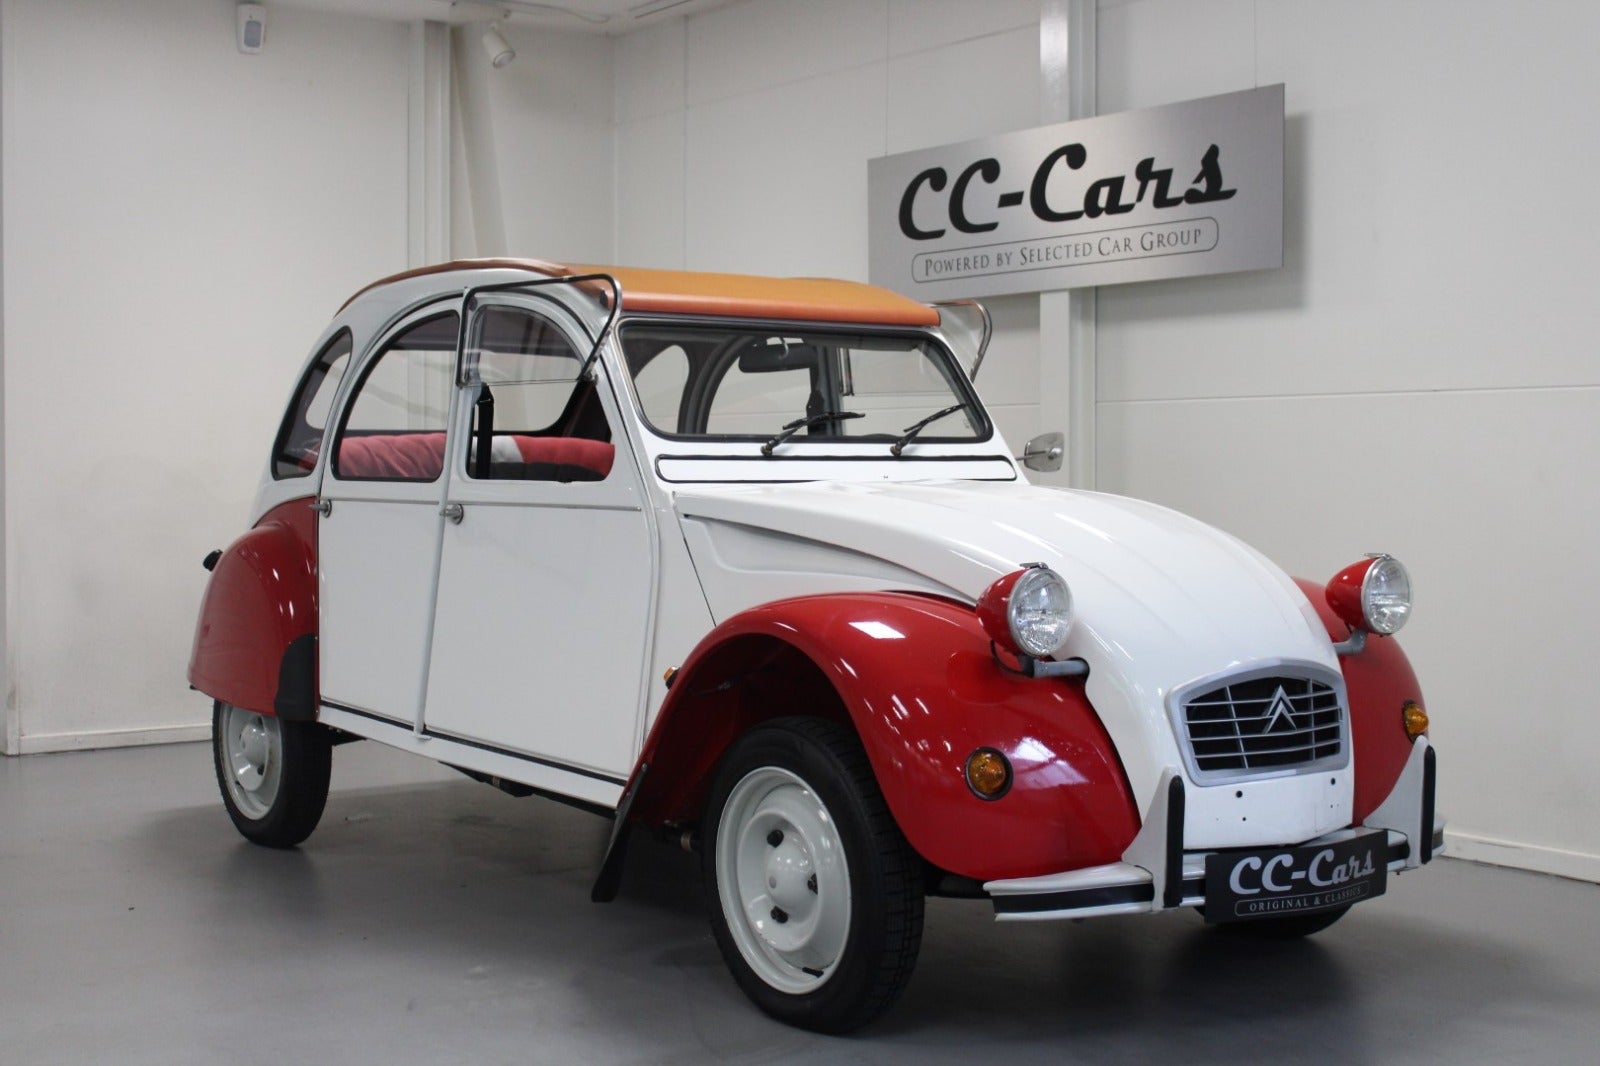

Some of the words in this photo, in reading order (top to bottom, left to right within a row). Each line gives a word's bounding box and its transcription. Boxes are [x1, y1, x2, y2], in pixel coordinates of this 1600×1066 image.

[899, 143, 1237, 240] CC-Cars
[925, 254, 990, 276] POWERED
[996, 251, 1013, 267] BY
[1020, 242, 1092, 266] SELECTED
[1098, 236, 1133, 257] CAR
[1140, 228, 1202, 252] GROUP
[1229, 849, 1375, 895] CC-Cars
[1249, 899, 1308, 912] ORIGINAL
[1314, 897, 1320, 905] &
[1325, 887, 1361, 903] CLASSICS
